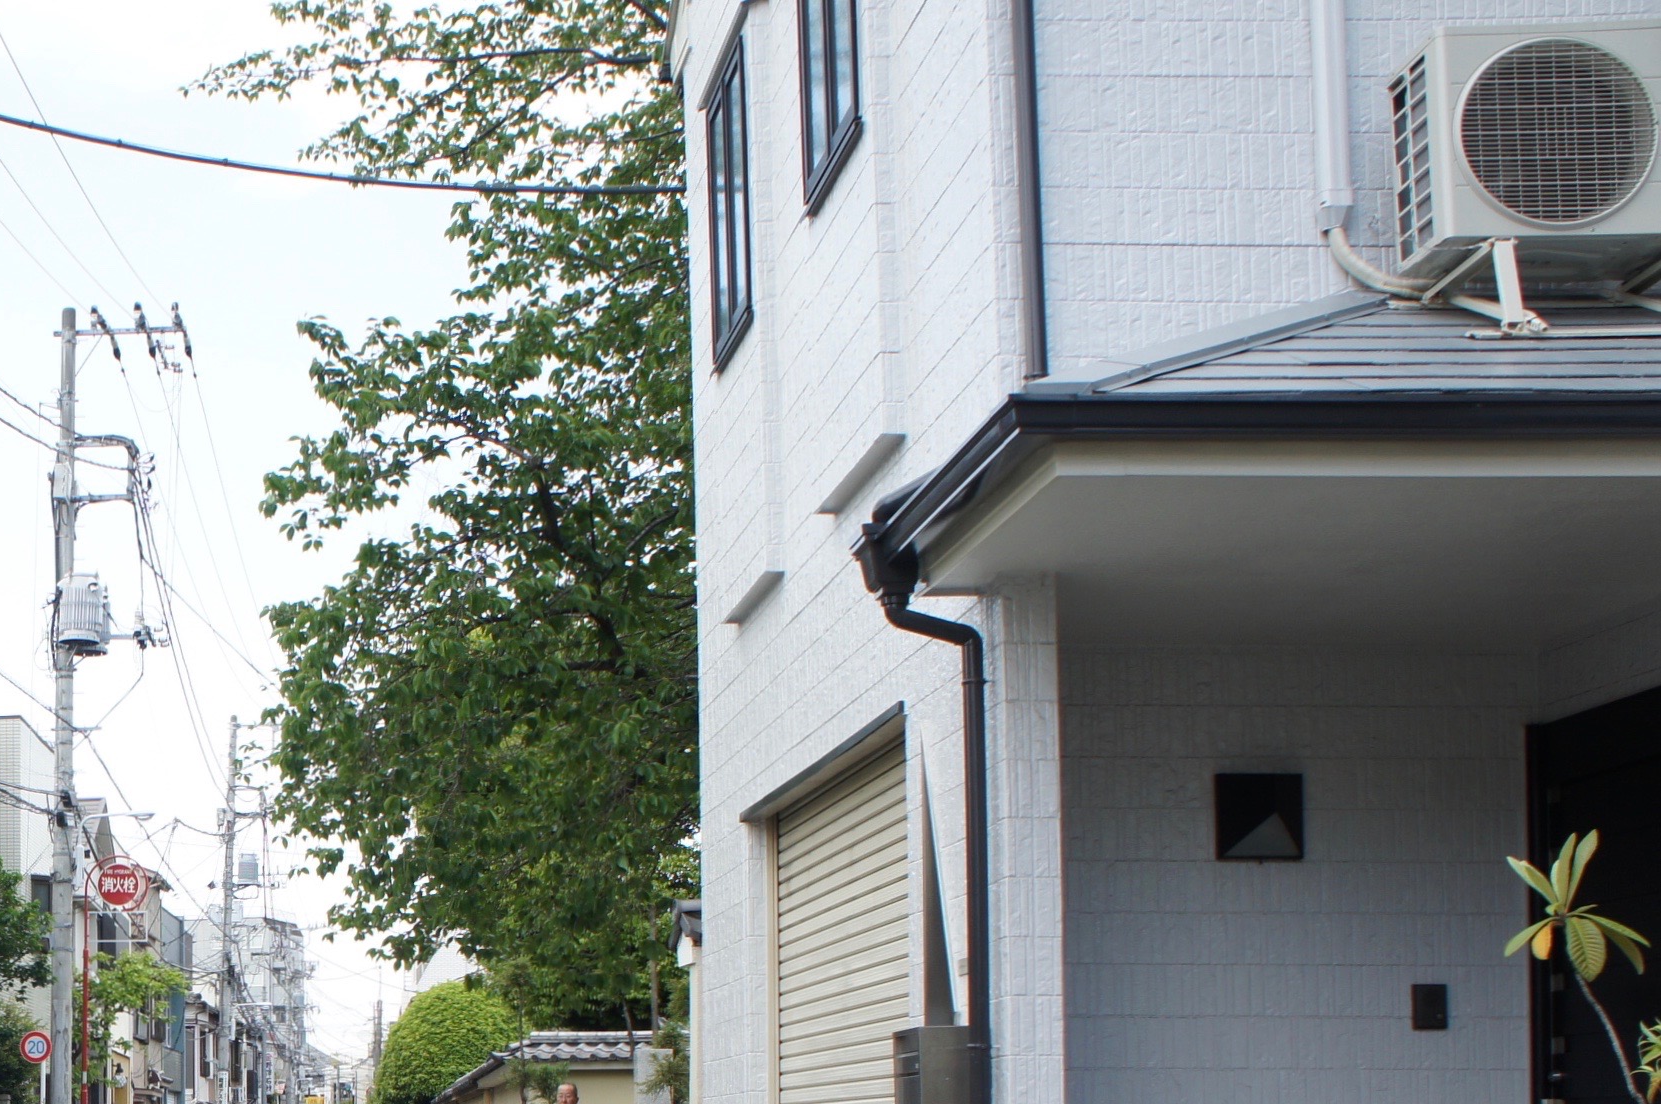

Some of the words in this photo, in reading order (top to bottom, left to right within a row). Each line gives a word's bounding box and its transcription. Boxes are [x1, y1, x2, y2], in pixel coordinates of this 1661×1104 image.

[101, 877, 136, 894] 消火栓
[27, 1040, 45, 1054] 20
